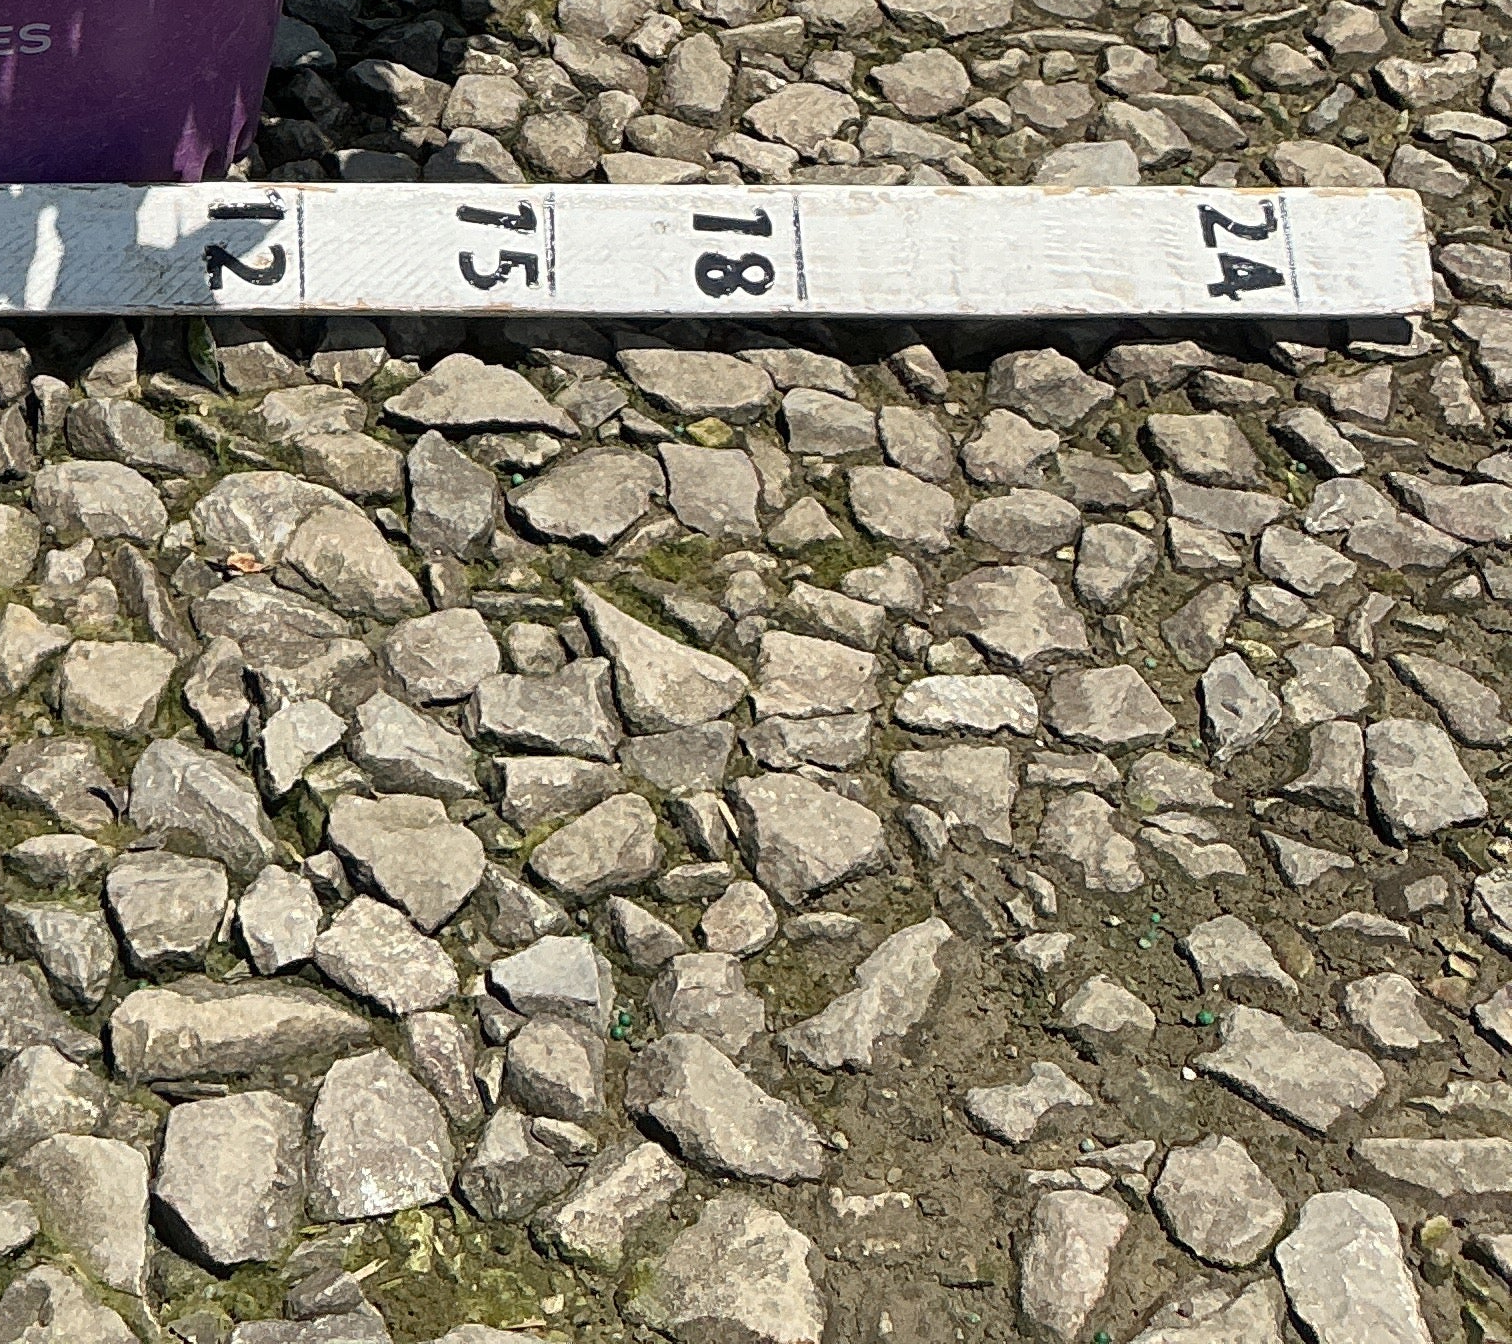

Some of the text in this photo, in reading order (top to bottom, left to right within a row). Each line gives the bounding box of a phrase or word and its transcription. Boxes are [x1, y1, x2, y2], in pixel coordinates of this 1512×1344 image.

[202, 188, 287, 290] 12
[456, 200, 539, 291] 15
[692, 208, 775, 298] 18
[1197, 199, 1285, 301] 24
